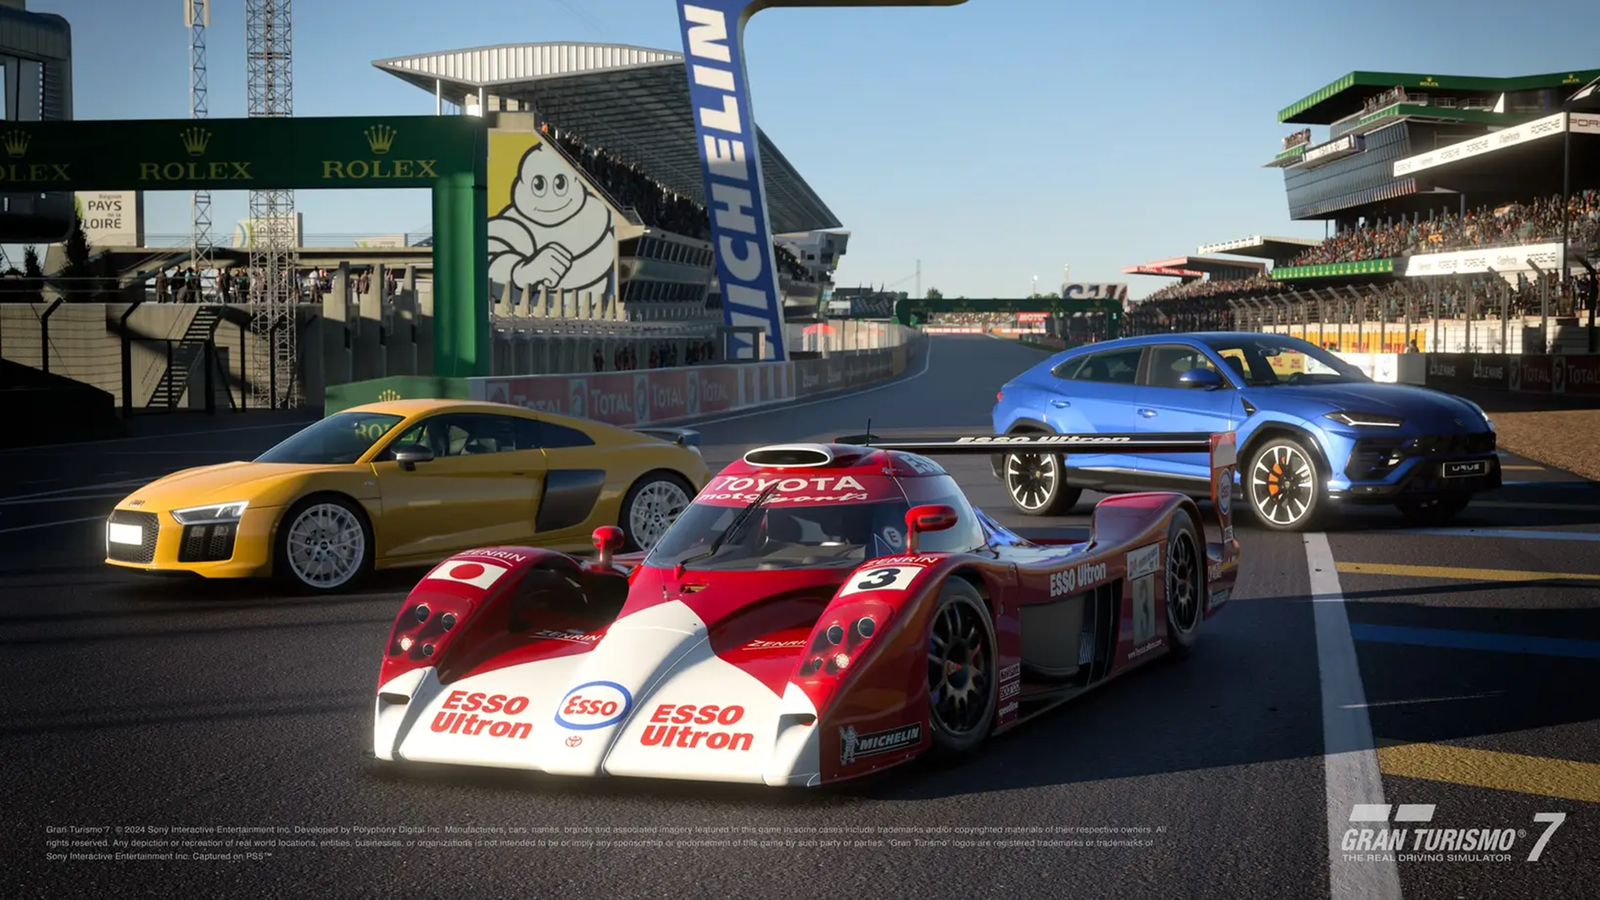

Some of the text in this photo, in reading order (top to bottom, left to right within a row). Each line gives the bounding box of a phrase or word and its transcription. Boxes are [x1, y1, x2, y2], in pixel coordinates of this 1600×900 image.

[0, 163, 72, 182] LEX
[138, 160, 255, 181] ROLEX
[321, 158, 440, 179] ROLEX
[684, 4, 776, 359] MICHELIN
[88, 200, 122, 211] PAYS
[83, 218, 121, 229] LOIRE
[1522, 364, 1550, 383] TOTAL
[1567, 365, 1600, 384] TOTAL
[652, 385, 685, 408] TOTAL
[701, 379, 728, 400] TOTAL
[590, 388, 633, 414] TOTAL
[715, 476, 866, 492] TOYOTA
[887, 530, 899, 543] E
[459, 549, 526, 562] ZENRIN
[863, 556, 938, 567] ZENRIN
[857, 568, 901, 590] 3
[1050, 569, 1075, 597] ESSO
[1077, 562, 1106, 587] Ultron
[535, 629, 602, 641] ZENRIN
[441, 689, 530, 715] ESSO
[563, 694, 618, 717] Esso
[650, 704, 745, 725] ESSO
[430, 712, 533, 739] Ultron
[640, 725, 754, 751] Ultron
[859, 727, 919, 751] MICHELIN
